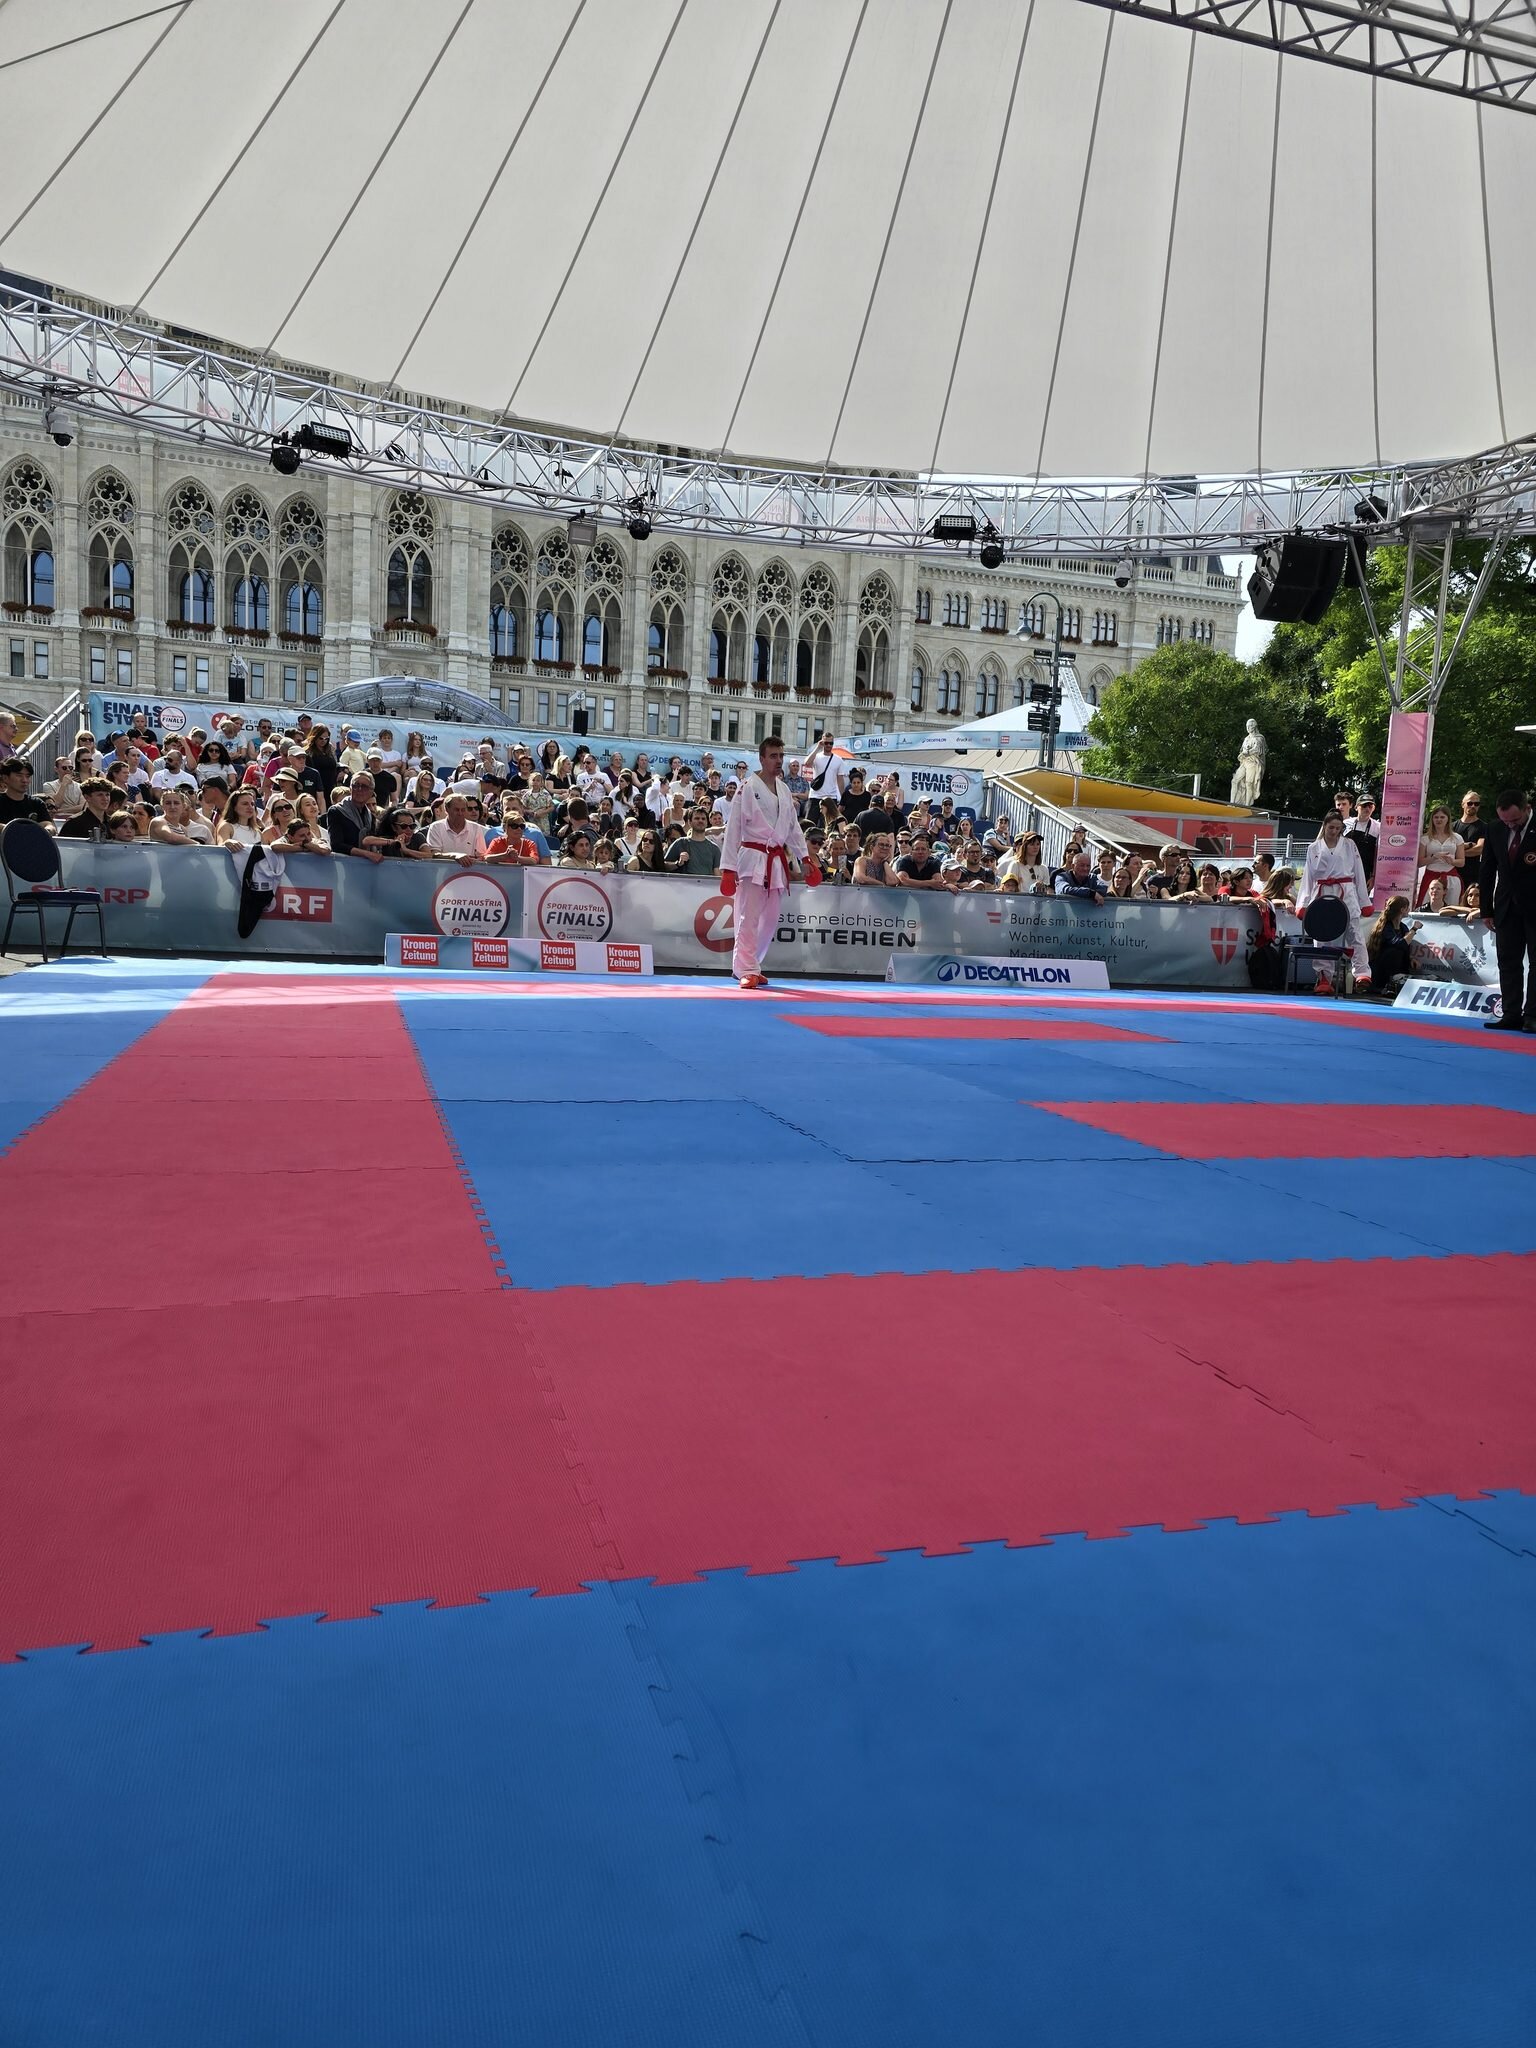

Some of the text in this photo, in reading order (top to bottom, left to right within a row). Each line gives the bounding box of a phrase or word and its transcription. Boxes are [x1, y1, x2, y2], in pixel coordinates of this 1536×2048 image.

[103, 701, 162, 717] FINALS
[911, 772, 952, 783] FINALS
[911, 781, 951, 793] FINALS
[468, 899, 502, 907] AUSTRIA
[546, 903, 605, 912] SPORT AUSTRIA
[440, 907, 503, 922] FINALS
[546, 911, 606, 927] FINALS
[778, 913, 917, 929] sterreichische
[1010, 913, 1125, 929] Bundesministerium
[772, 927, 916, 948] OTTERIEN
[1008, 931, 1149, 950] Wohnen, Kunst, Kultur,
[402, 939, 437, 950] Kronen
[473, 941, 507, 953] Kronen
[542, 944, 574, 955] Kronen
[403, 950, 437, 962] Zeitung
[608, 946, 639, 958] Kronen
[1410, 943, 1455, 960] USTRIA
[474, 952, 507, 964] Zeitung
[543, 955, 575, 966] Zeitung
[609, 957, 640, 969] Zeitung
[964, 965, 1071, 983] DECATHLON
[1411, 986, 1503, 1014] FINALS
